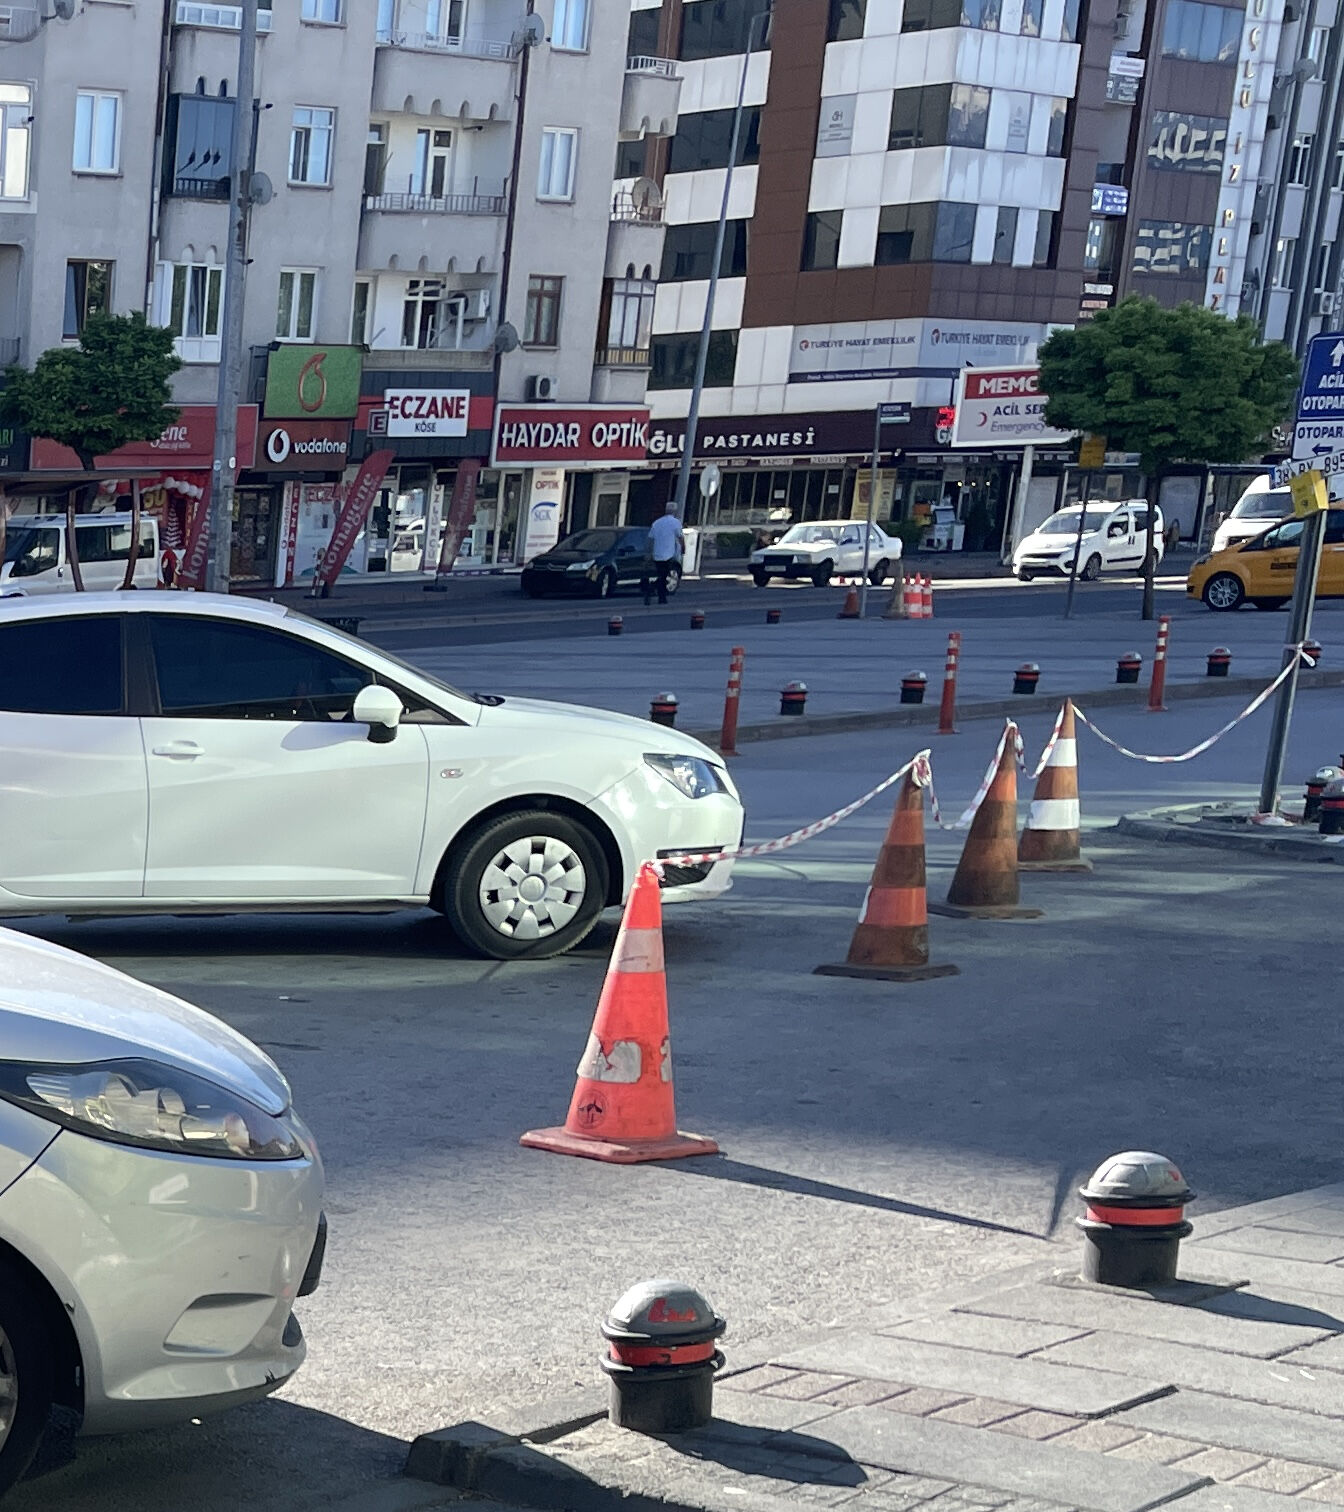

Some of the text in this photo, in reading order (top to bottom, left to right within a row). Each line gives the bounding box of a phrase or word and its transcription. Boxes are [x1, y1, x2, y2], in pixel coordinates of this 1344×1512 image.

[389, 396, 466, 420] ECZANE
[993, 401, 1021, 416] ACİL
[374, 417, 385, 431] E
[414, 421, 437, 433] KÖSE
[501, 417, 649, 448] HAYDAR OPTİK
[294, 438, 347, 454] vodafone
[703, 427, 816, 450] PASTANESİ
[322, 472, 372, 576] komagene
